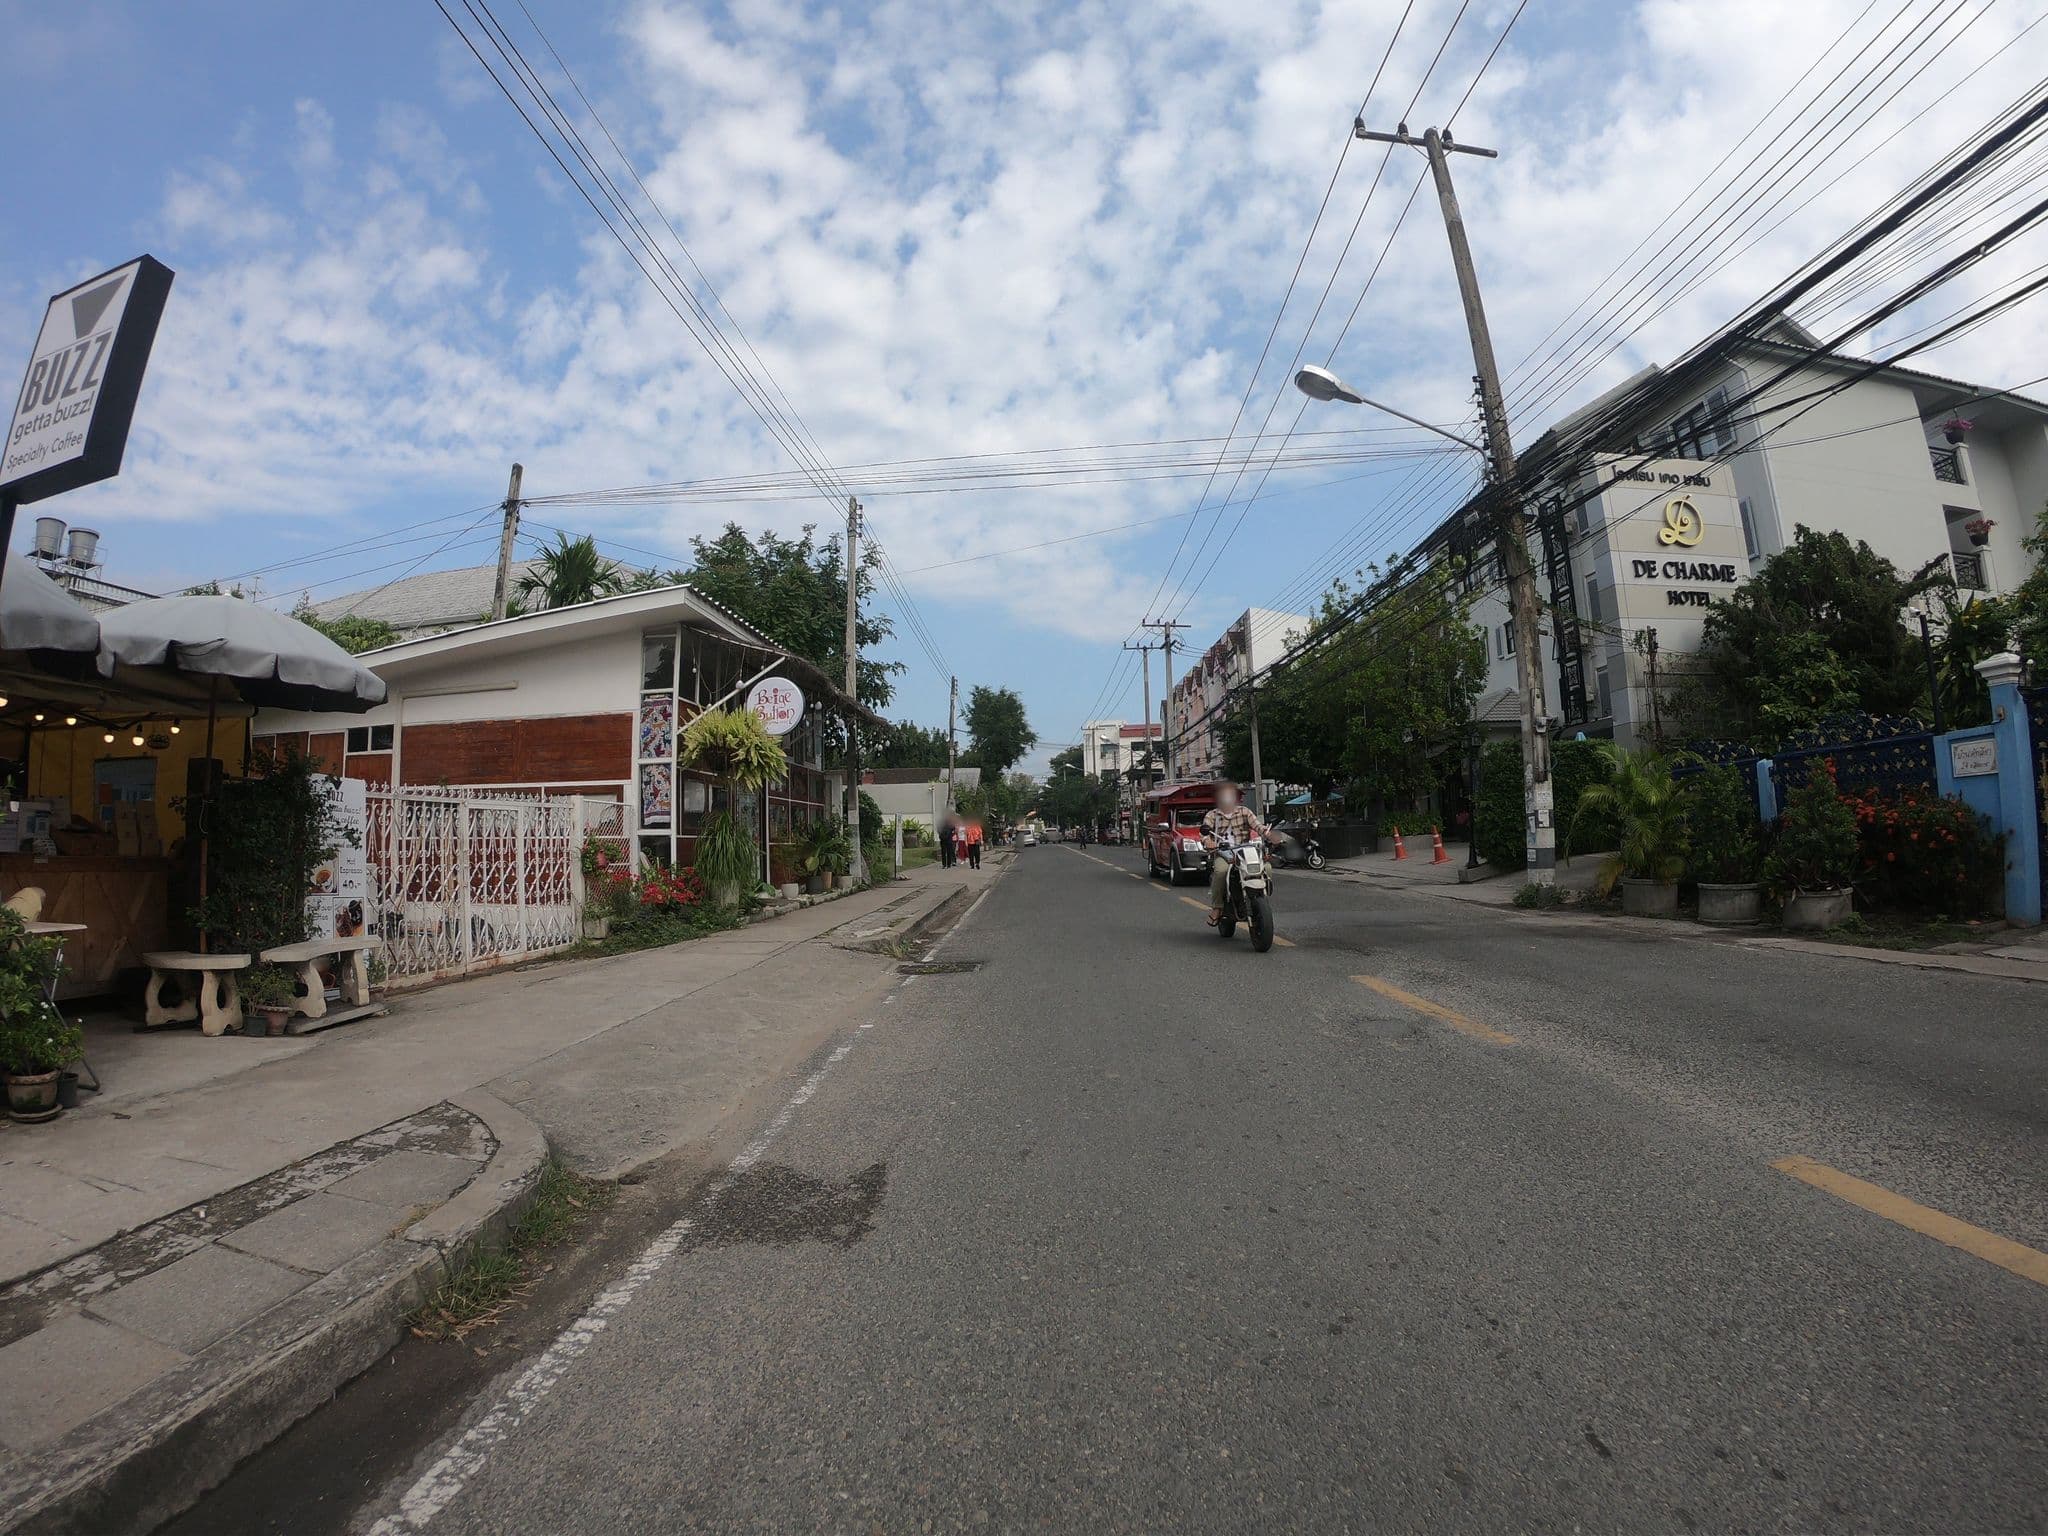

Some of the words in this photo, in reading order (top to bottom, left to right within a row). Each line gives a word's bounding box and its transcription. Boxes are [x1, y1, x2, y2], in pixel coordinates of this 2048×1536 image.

[21, 331, 112, 415] BUZZ
[13, 412, 52, 445] getta
[52, 390, 95, 425] buzz!
[6, 442, 49, 473] Specialty
[51, 430, 83, 454] Coffee
[1632, 560, 1659, 578] DE
[1662, 561, 1737, 582] CHARME
[754, 687, 791, 706] Beige
